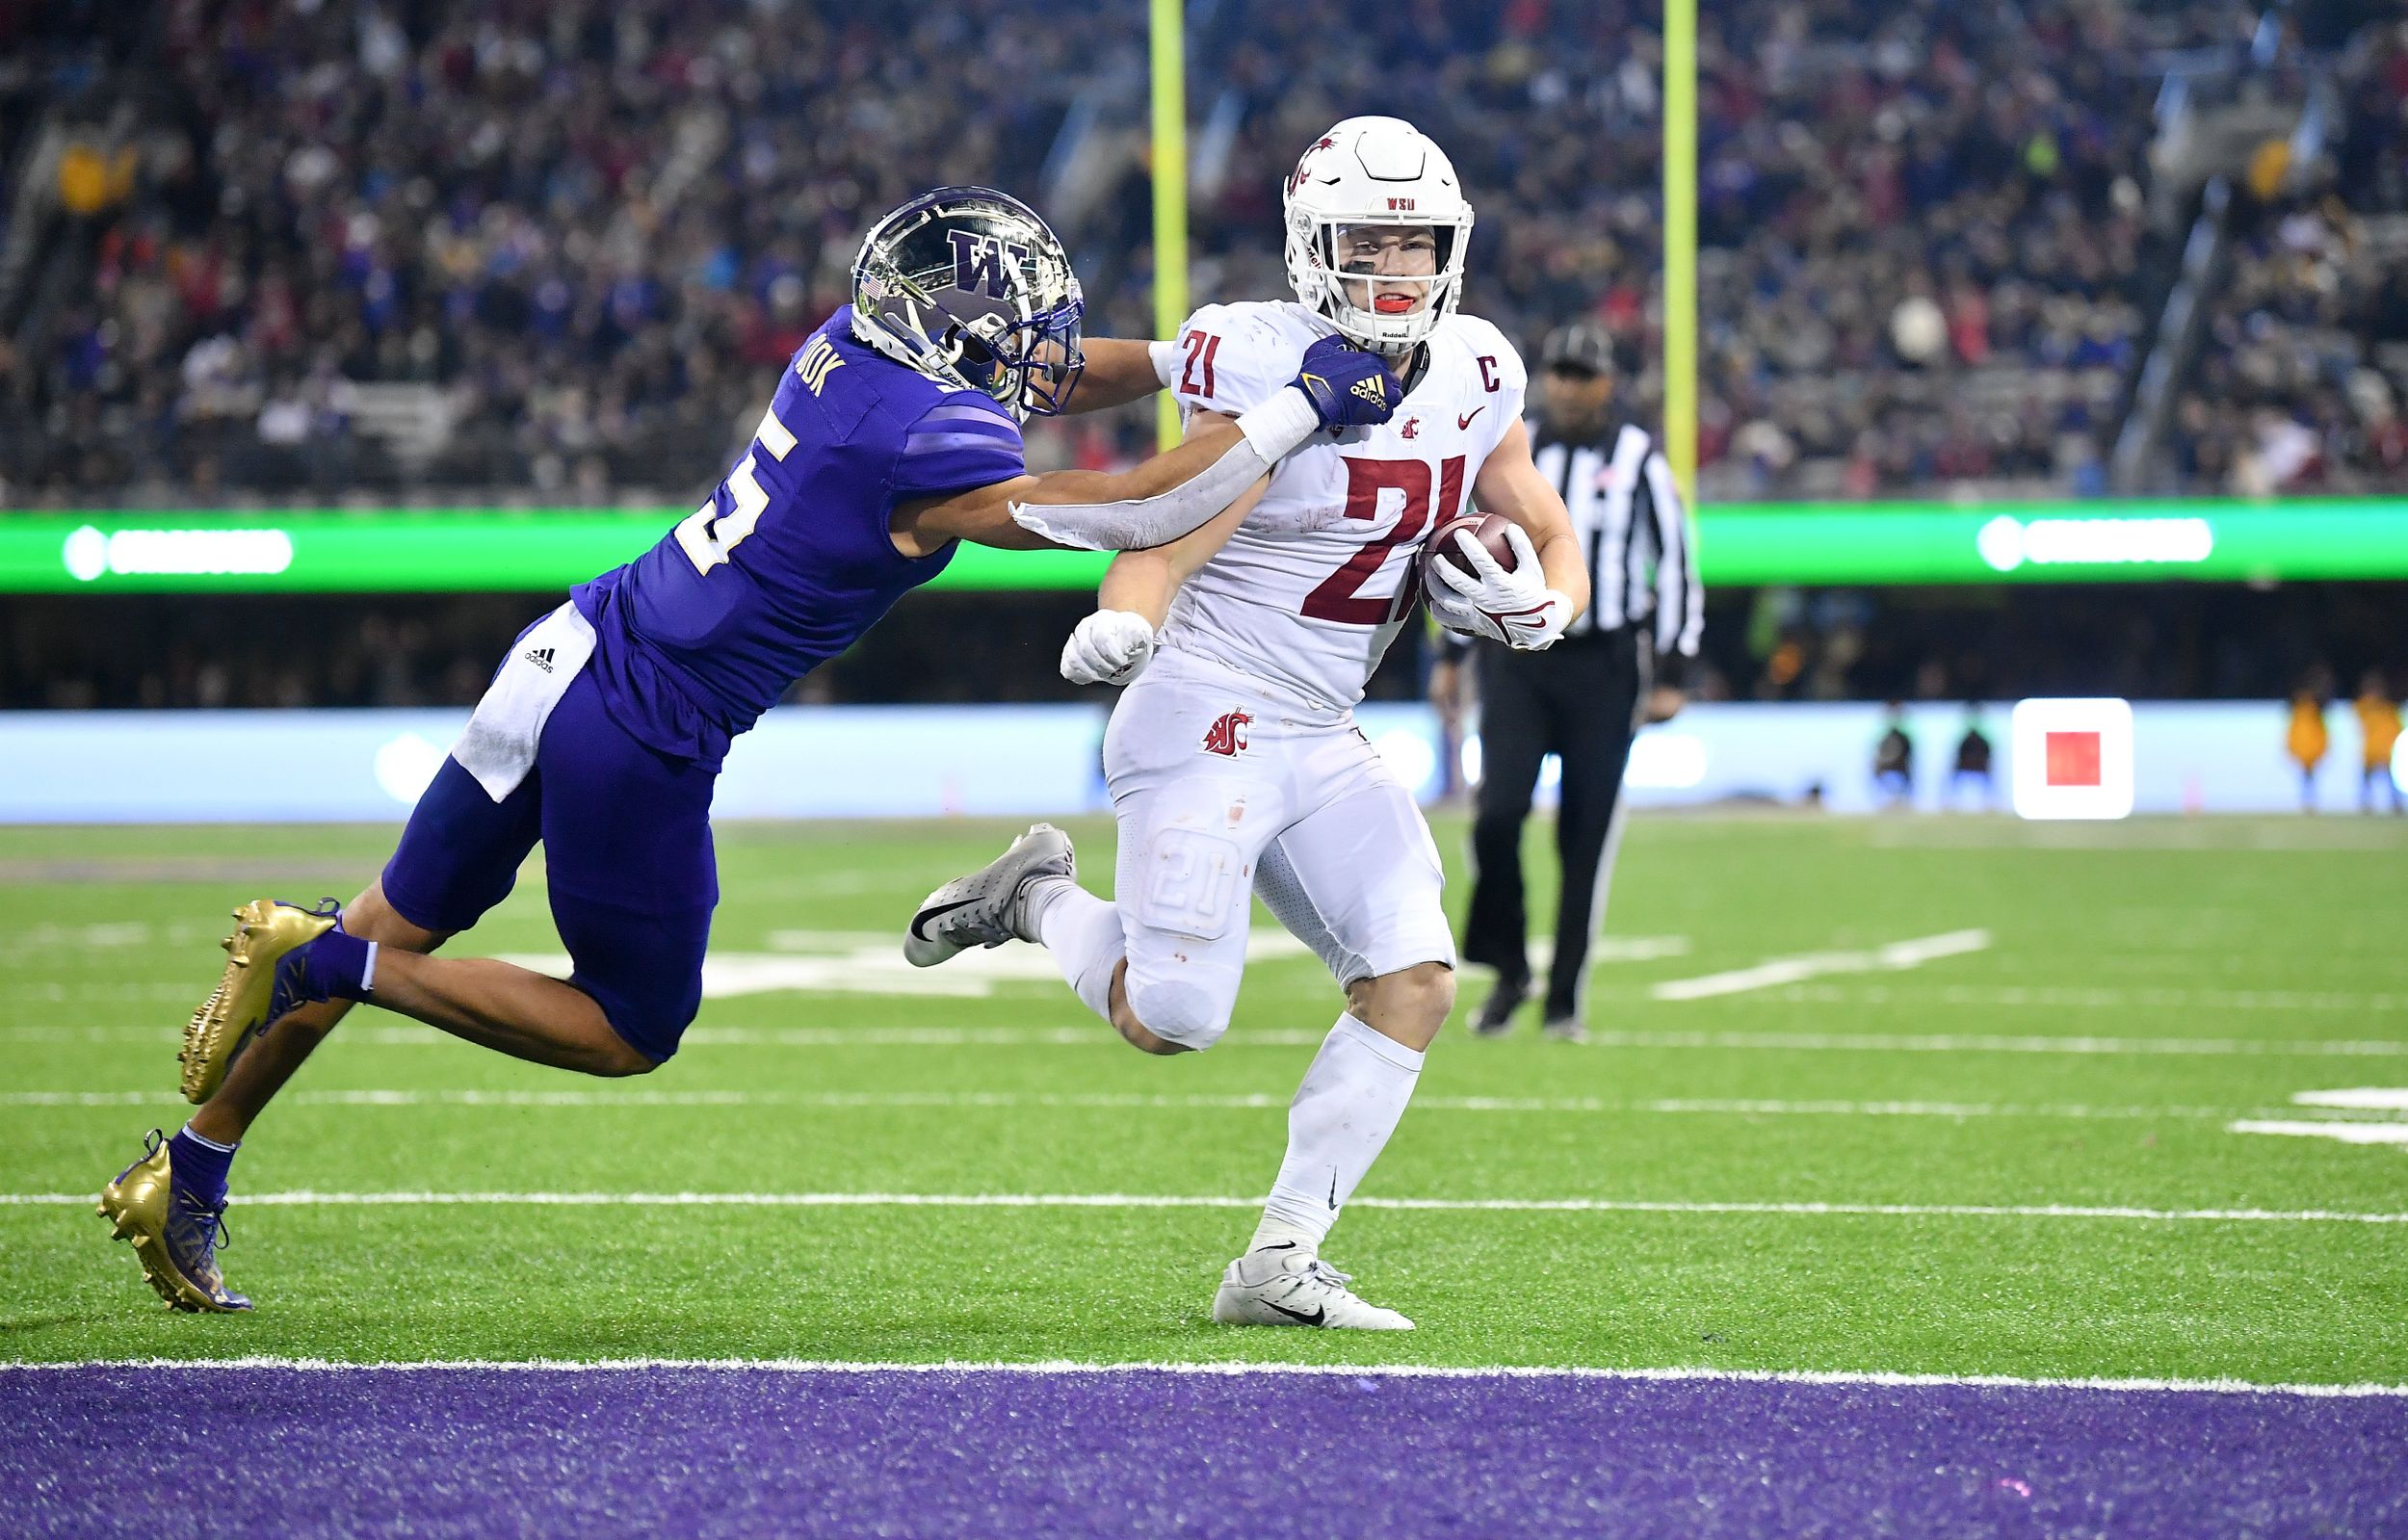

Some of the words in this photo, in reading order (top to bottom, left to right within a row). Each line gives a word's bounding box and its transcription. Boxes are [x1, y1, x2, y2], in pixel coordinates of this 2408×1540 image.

[1387, 197, 1415, 211] WSU
[947, 229, 1030, 301] W
[1179, 329, 1221, 400] 21
[1349, 385, 1387, 412] adidas
[1477, 355, 1500, 393] C
[673, 398, 798, 577] 5
[1299, 455, 1466, 625] 21
[524, 652, 554, 674] adidas
[1152, 843, 1228, 916] 21
